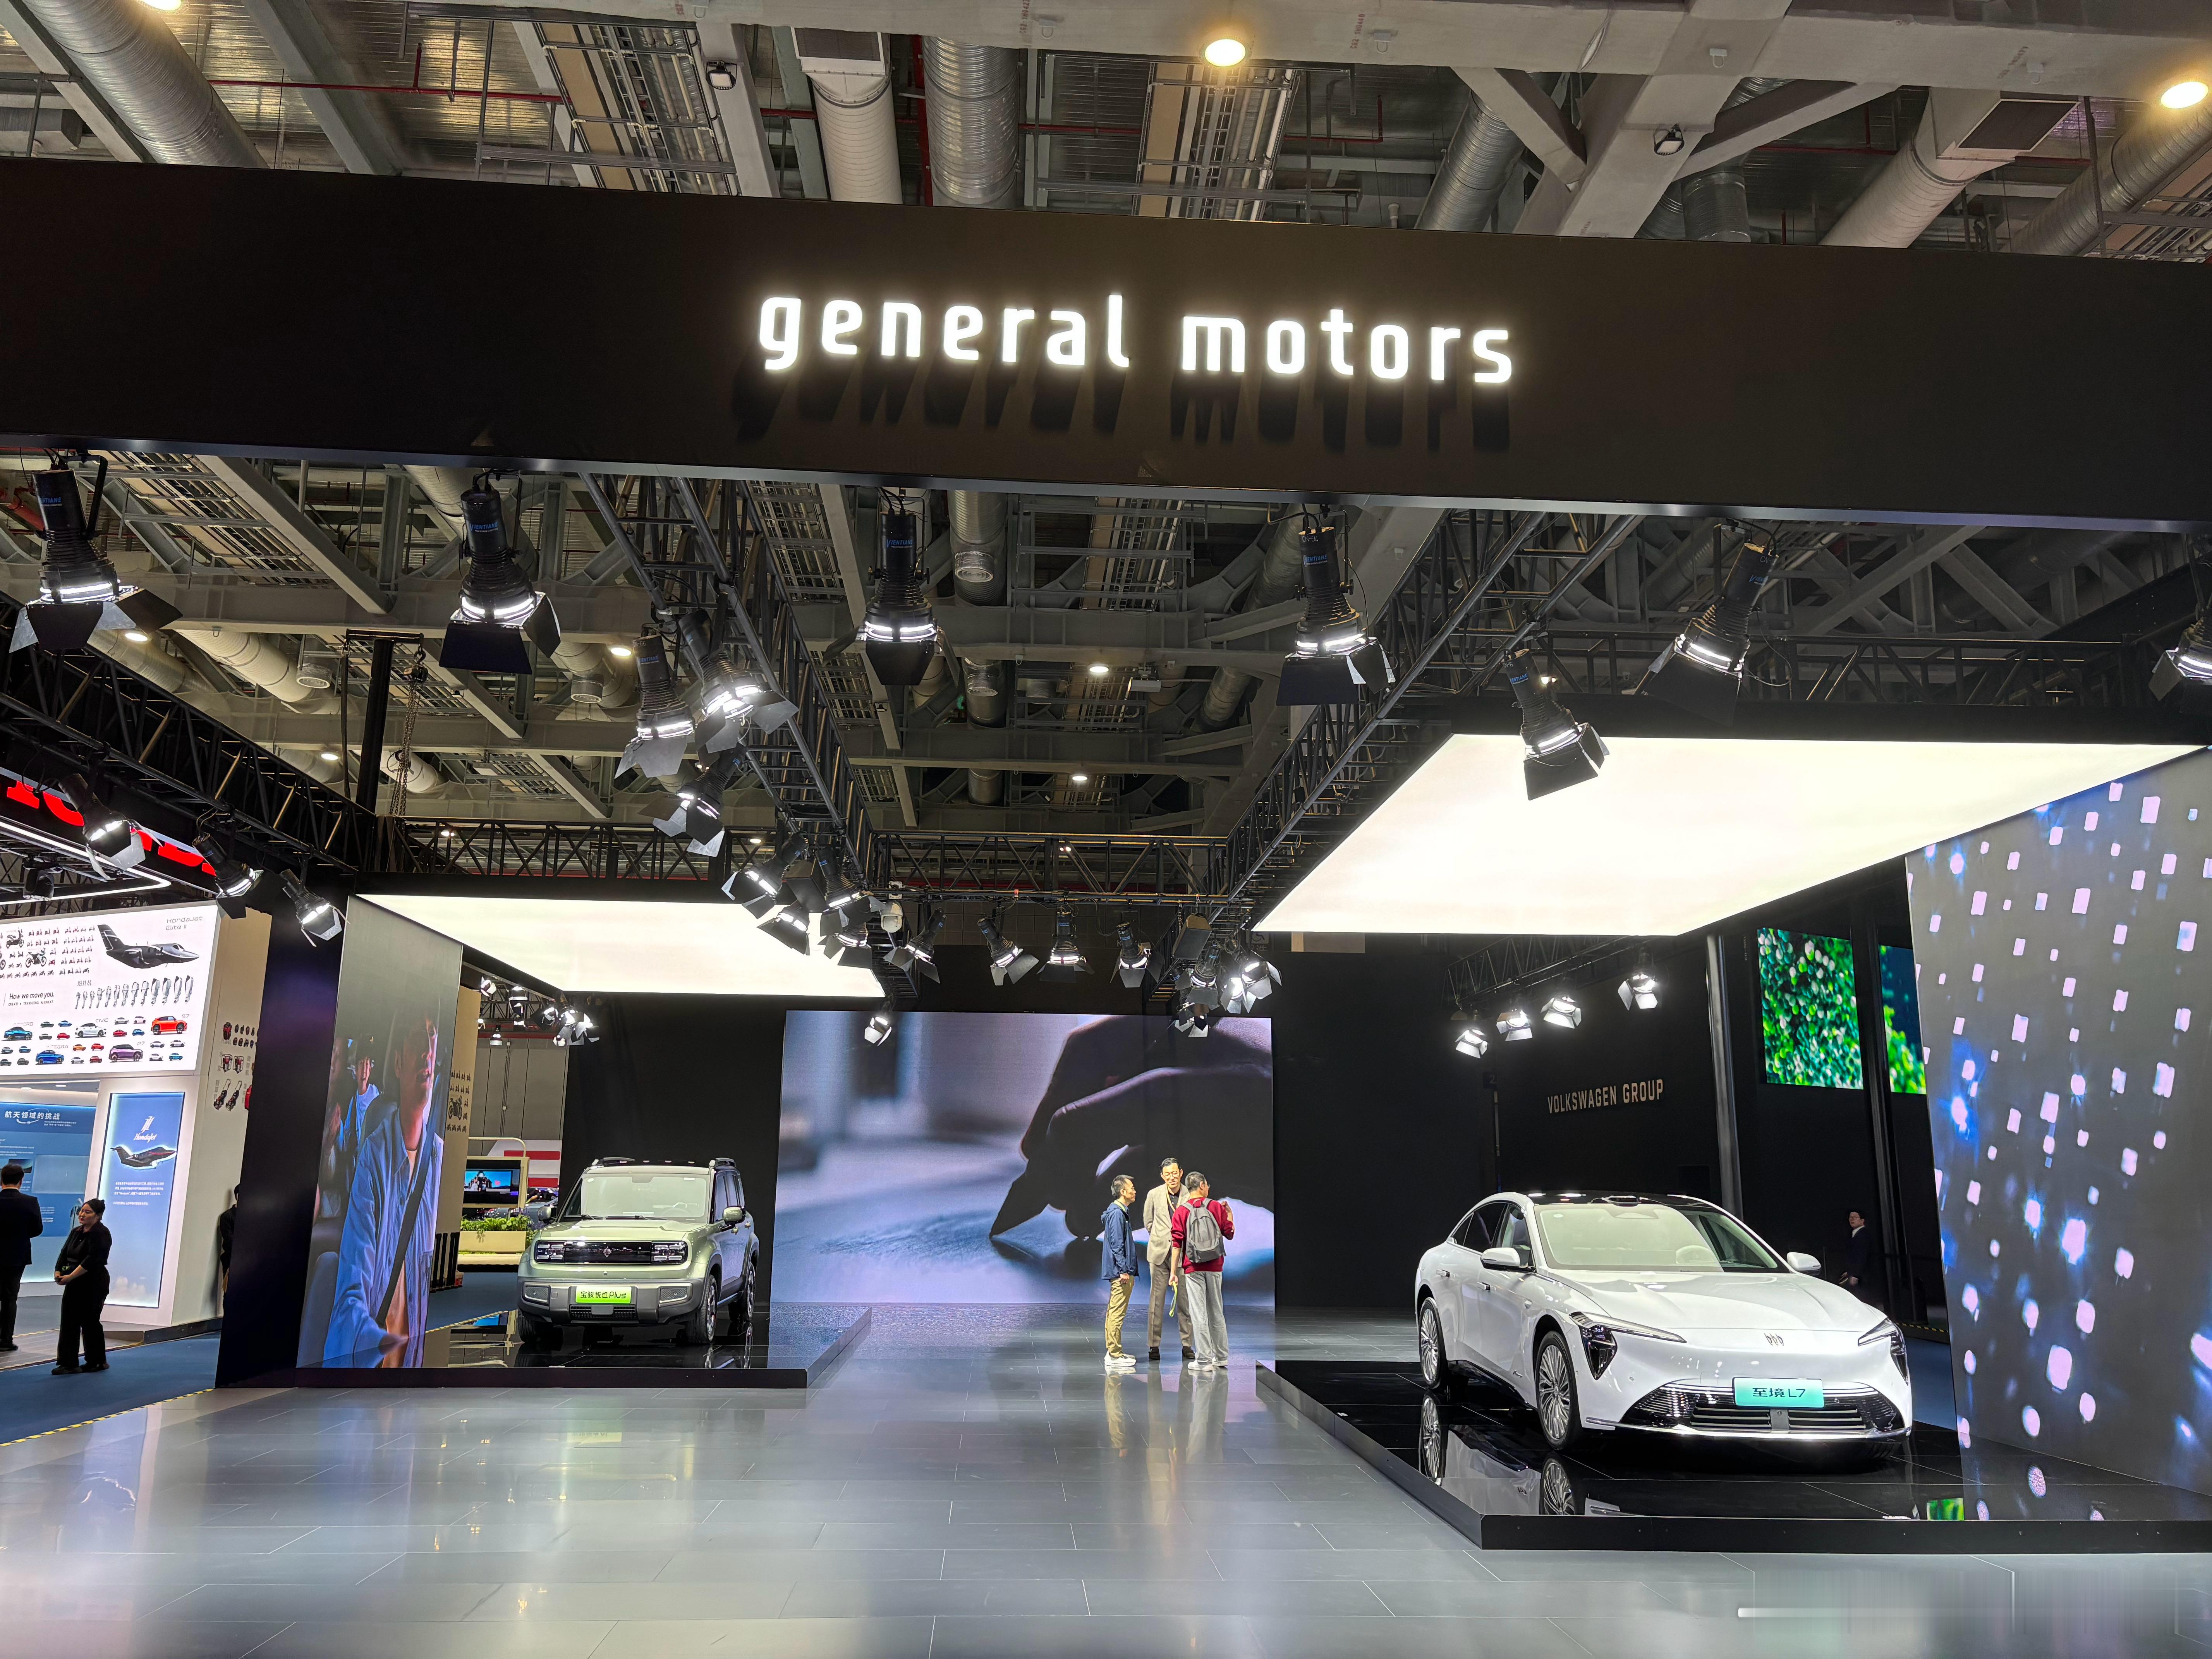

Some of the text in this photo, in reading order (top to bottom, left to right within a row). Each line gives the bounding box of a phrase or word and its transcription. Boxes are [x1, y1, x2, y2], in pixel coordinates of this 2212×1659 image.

[759, 294, 1512, 383] general motors
[886, 539, 913, 548] VIENTIANE
[1547, 1079, 1664, 1114] VOLKSWAGEN GROUP
[4, 1111, 61, 1120] 航天领域的挑战
[1752, 1388, 1806, 1398] 至境 L7
